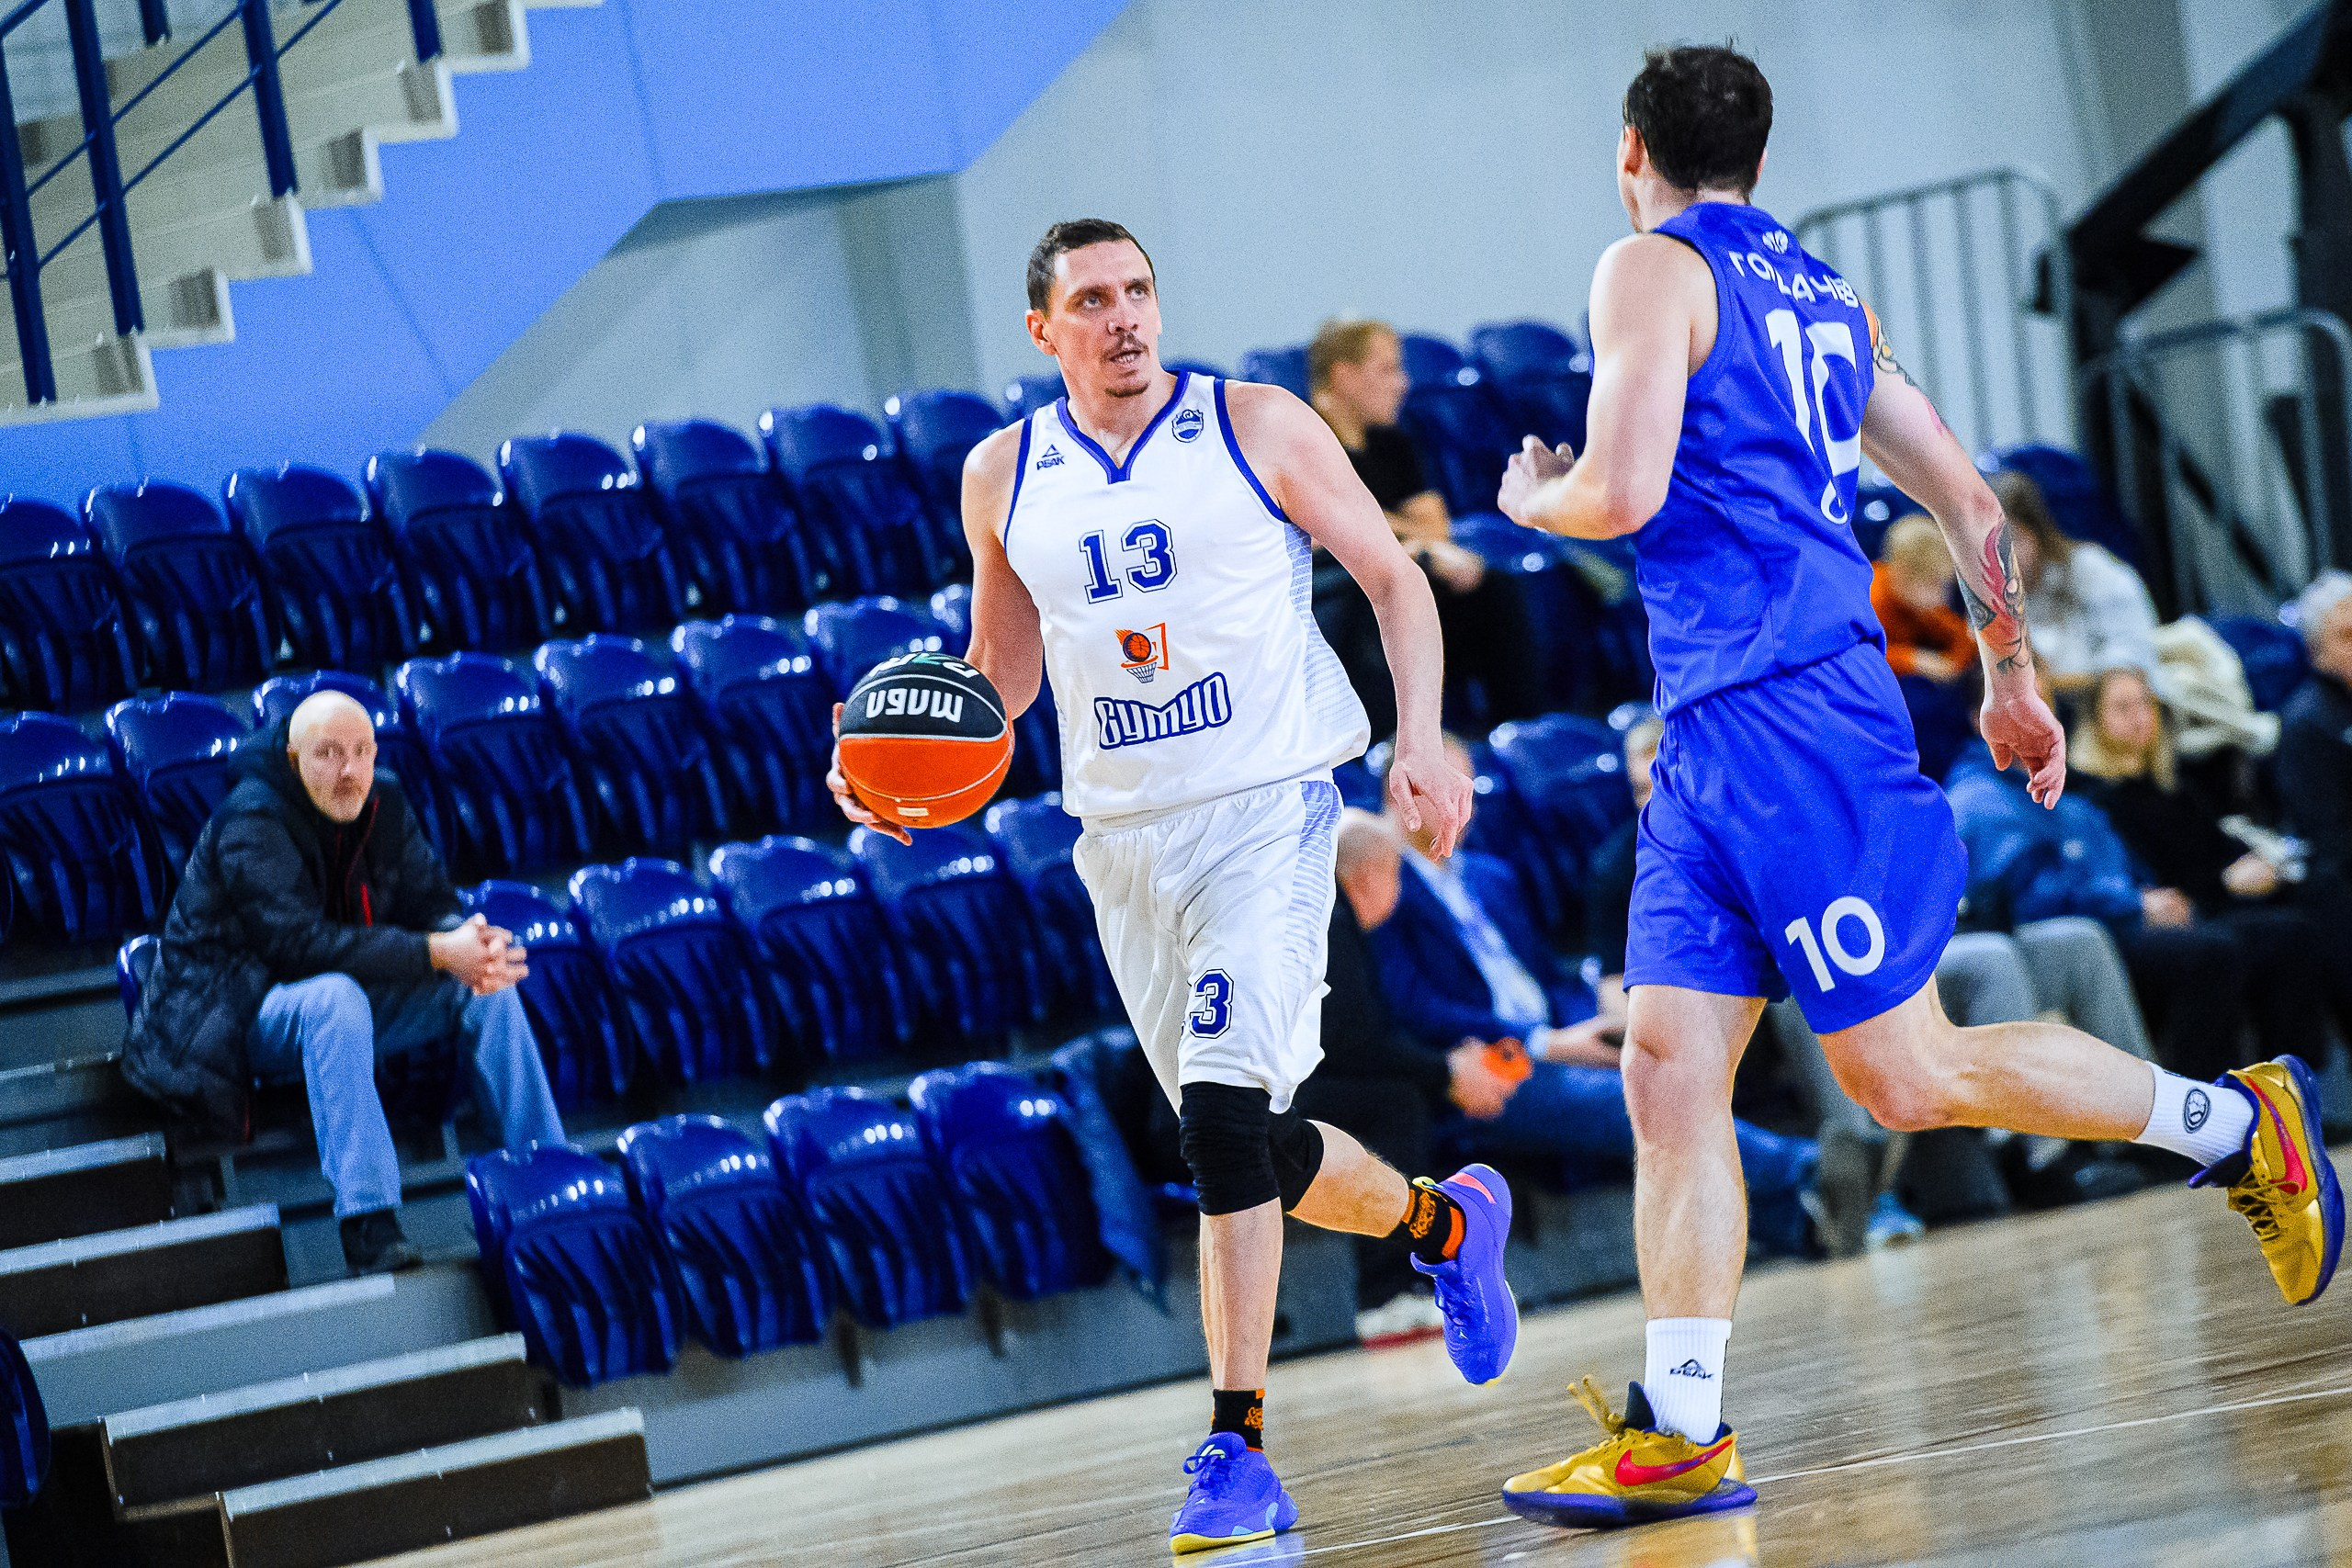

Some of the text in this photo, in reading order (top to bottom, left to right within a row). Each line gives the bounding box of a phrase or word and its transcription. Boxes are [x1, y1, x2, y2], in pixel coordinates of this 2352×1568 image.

[1764, 309, 1861, 478] 10
[1036, 456, 1065, 470] PEAK
[1079, 518, 1177, 604] 13
[1784, 895, 1886, 993] 10
[1185, 968, 1234, 1039] 3
